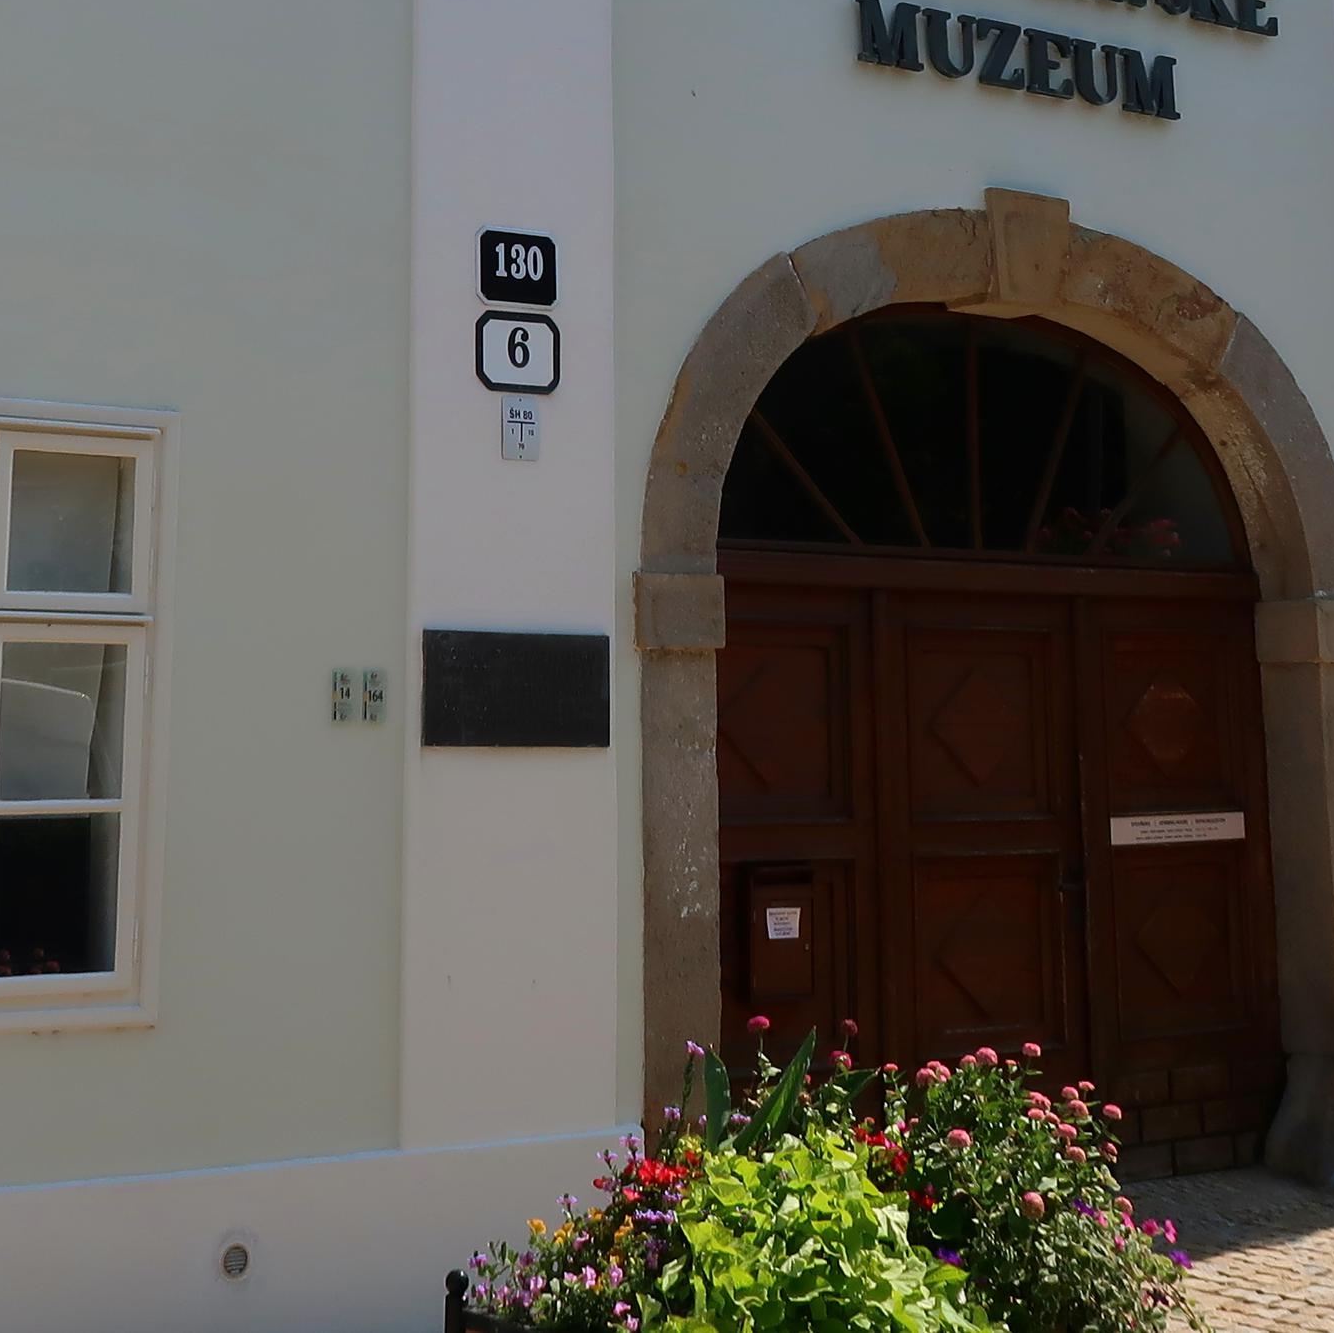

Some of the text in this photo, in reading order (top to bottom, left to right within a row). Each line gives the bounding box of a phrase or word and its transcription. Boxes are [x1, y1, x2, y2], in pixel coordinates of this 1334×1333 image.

[495, 242, 544, 281] 130
[507, 326, 531, 368] 6
[523, 410, 533, 420] 80
[368, 689, 384, 703] 164
